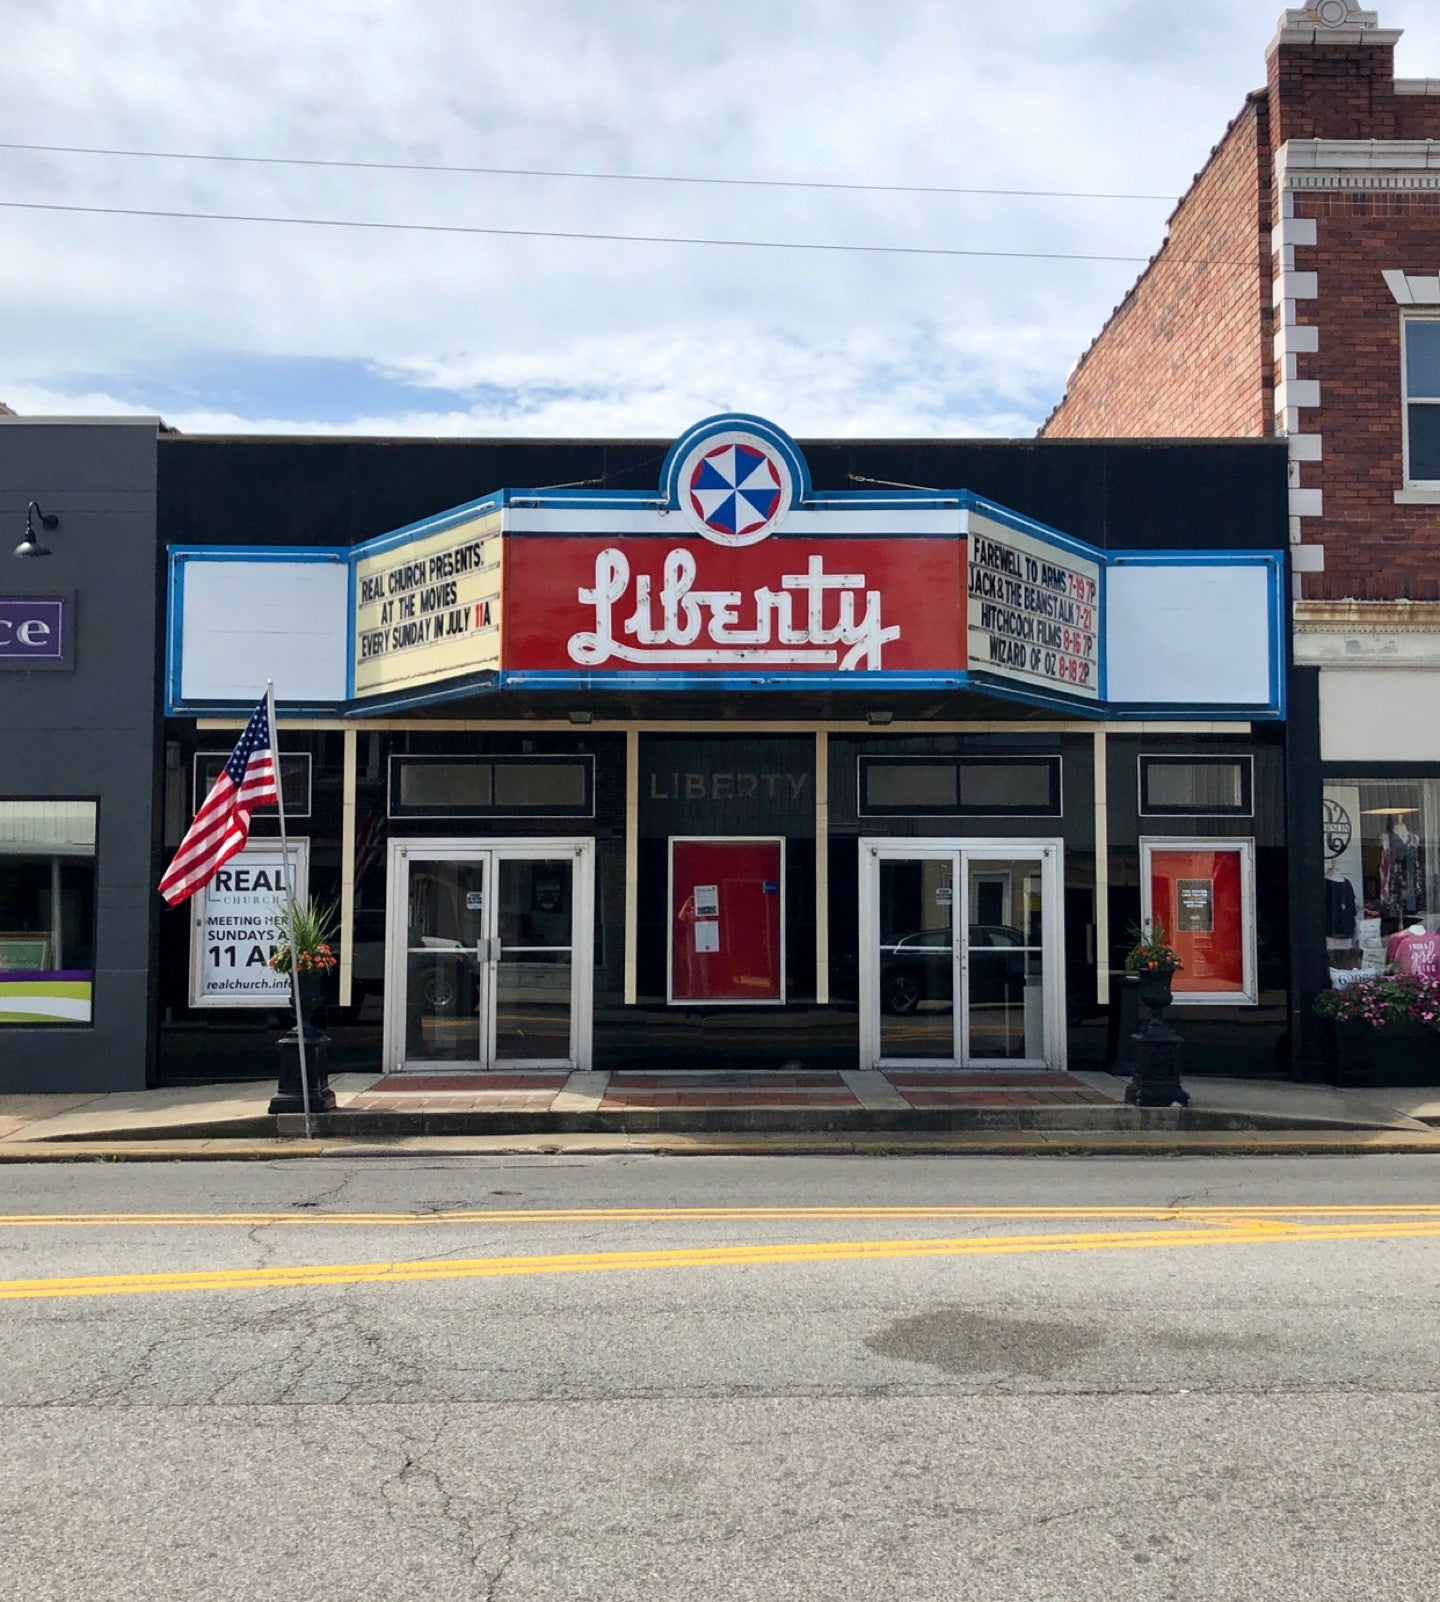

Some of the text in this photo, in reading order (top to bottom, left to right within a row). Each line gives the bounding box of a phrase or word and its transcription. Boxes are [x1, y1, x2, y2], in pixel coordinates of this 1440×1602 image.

[362, 575, 385, 602] REAL
[388, 563, 426, 595] CHURCH
[974, 538, 1096, 603] FAREWELL TO ARMS 7-19 7P
[381, 581, 457, 625] AT THE MOVIES
[567, 548, 900, 671] Liberty
[968, 567, 1092, 631] JACK & THE BEANSTALK 7-21
[362, 601, 490, 657] EVERY SUNDAY IN JULY 11A
[981, 602, 1093, 656] HITCHCOCK FILMS 8-16 7P
[990, 636, 1089, 684] WIZARD OF OZ 8-18 2P
[651, 773, 808, 799] LIBERTY
[215, 870, 287, 892] REAL
[224, 895, 280, 905] CHURCH
[208, 916, 289, 926] MEETING HER
[208, 930, 291, 941] SUNDAYS A
[208, 945, 236, 967] 11
